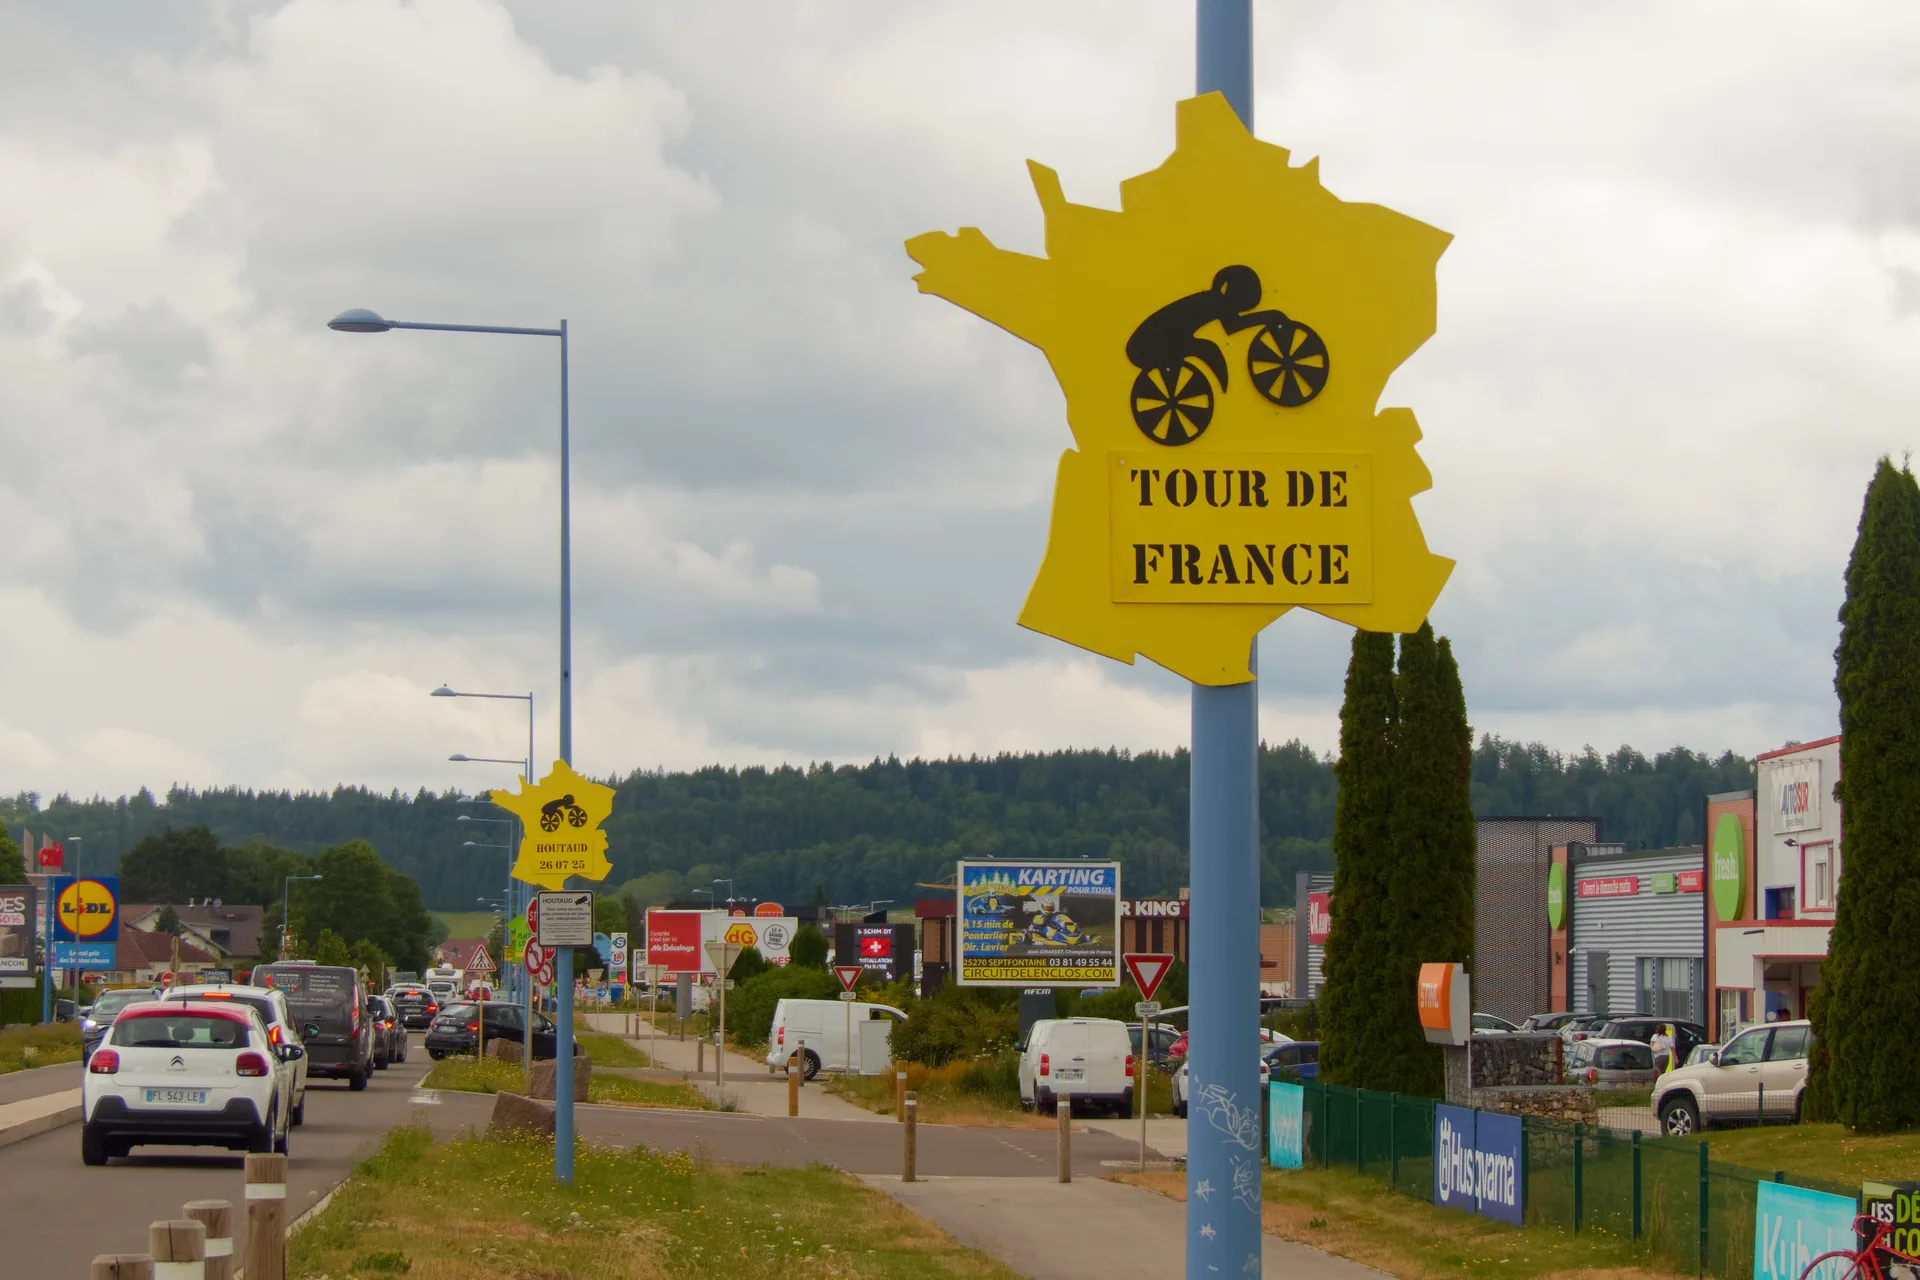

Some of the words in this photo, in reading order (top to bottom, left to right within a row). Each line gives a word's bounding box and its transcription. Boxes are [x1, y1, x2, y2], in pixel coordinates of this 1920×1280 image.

[1131, 469, 1269, 508] TOUR
[1286, 470, 1348, 508] DE
[1132, 543, 1349, 585] FRANCE
[537, 843, 588, 853] HOUTAUD
[540, 860, 553, 869] 26
[555, 860, 569, 869] 07
[572, 860, 585, 869] 25
[1018, 868, 1104, 885] KARTING
[1067, 886, 1090, 894] POUR
[1091, 886, 1112, 894] TOUS
[1135, 901, 1181, 916] KING
[972, 920, 982, 928] 15
[984, 920, 1000, 928] min
[1003, 920, 1014, 928] de
[963, 931, 1008, 940] Pontarlier
[963, 943, 979, 951] Dir.
[981, 943, 1008, 951] Levier
[963, 959, 987, 967] 25270
[989, 959, 1047, 967] SEPTFONTAINE
[1049, 959, 1060, 967] 03
[1062, 959, 1073, 967] 81
[1075, 959, 1087, 967] 49
[1088, 959, 1100, 967] 55
[1101, 959, 1113, 967] 44
[963, 968, 1113, 978] CIRCUITDELENCLOS.COM
[1451, 1132, 1515, 1209] Husqvarna
[1871, 1202, 1894, 1223] LES
